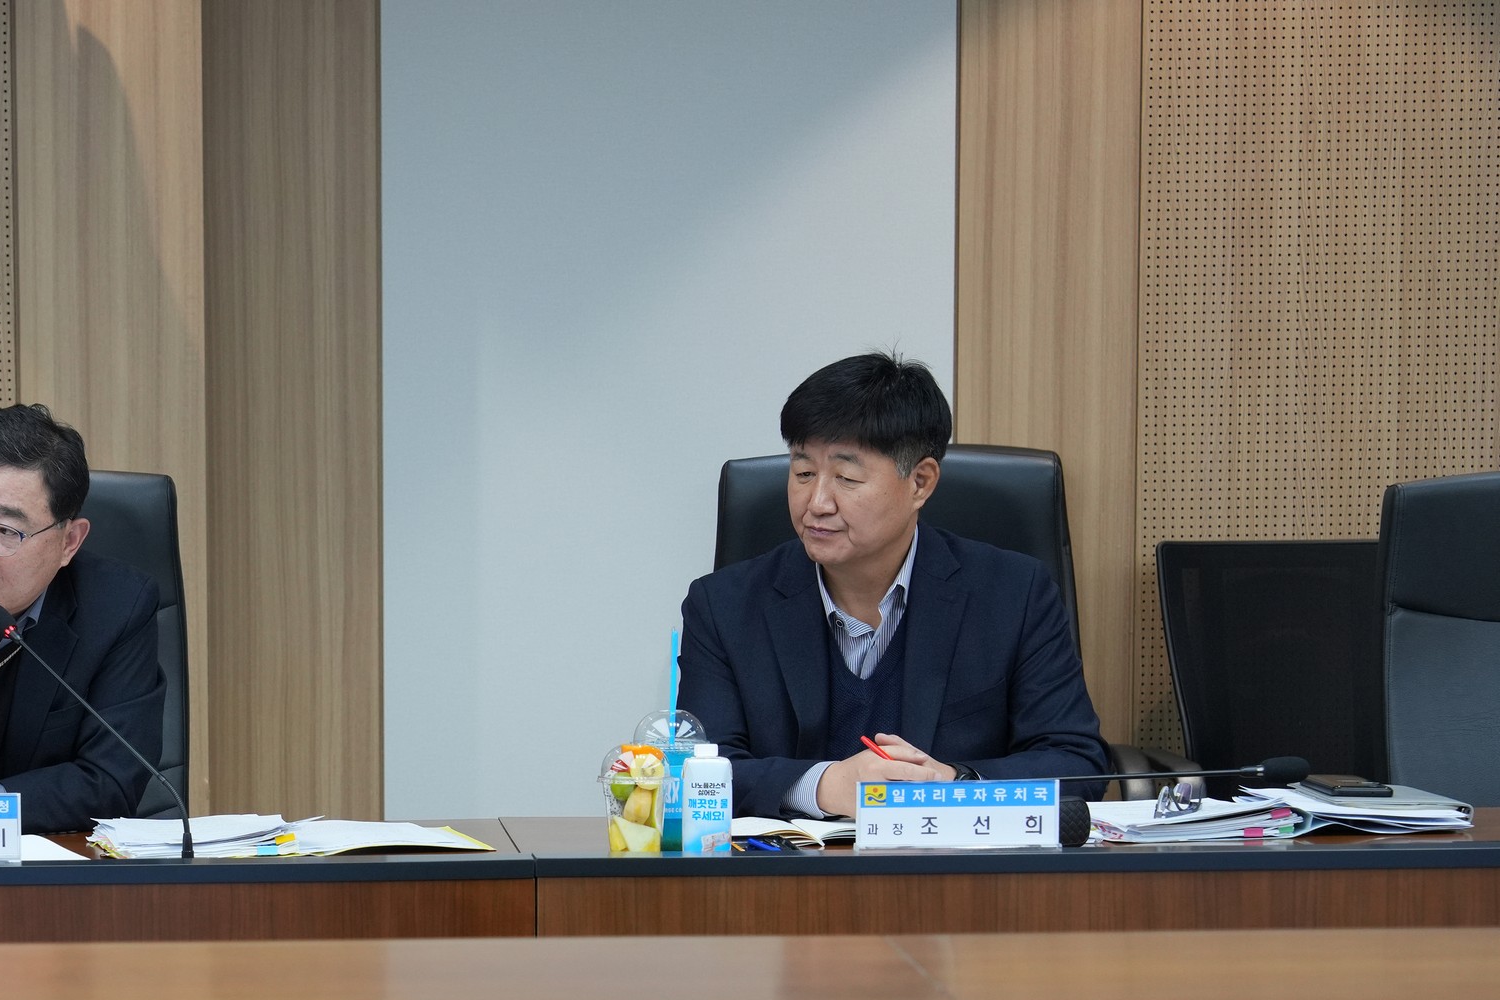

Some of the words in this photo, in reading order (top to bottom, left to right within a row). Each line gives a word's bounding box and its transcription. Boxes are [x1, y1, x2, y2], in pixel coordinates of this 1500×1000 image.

[891, 787, 1049, 803] 일자리투자유치국
[688, 798, 718, 809] 깨끗한
[691, 810, 725, 821] 주세요!
